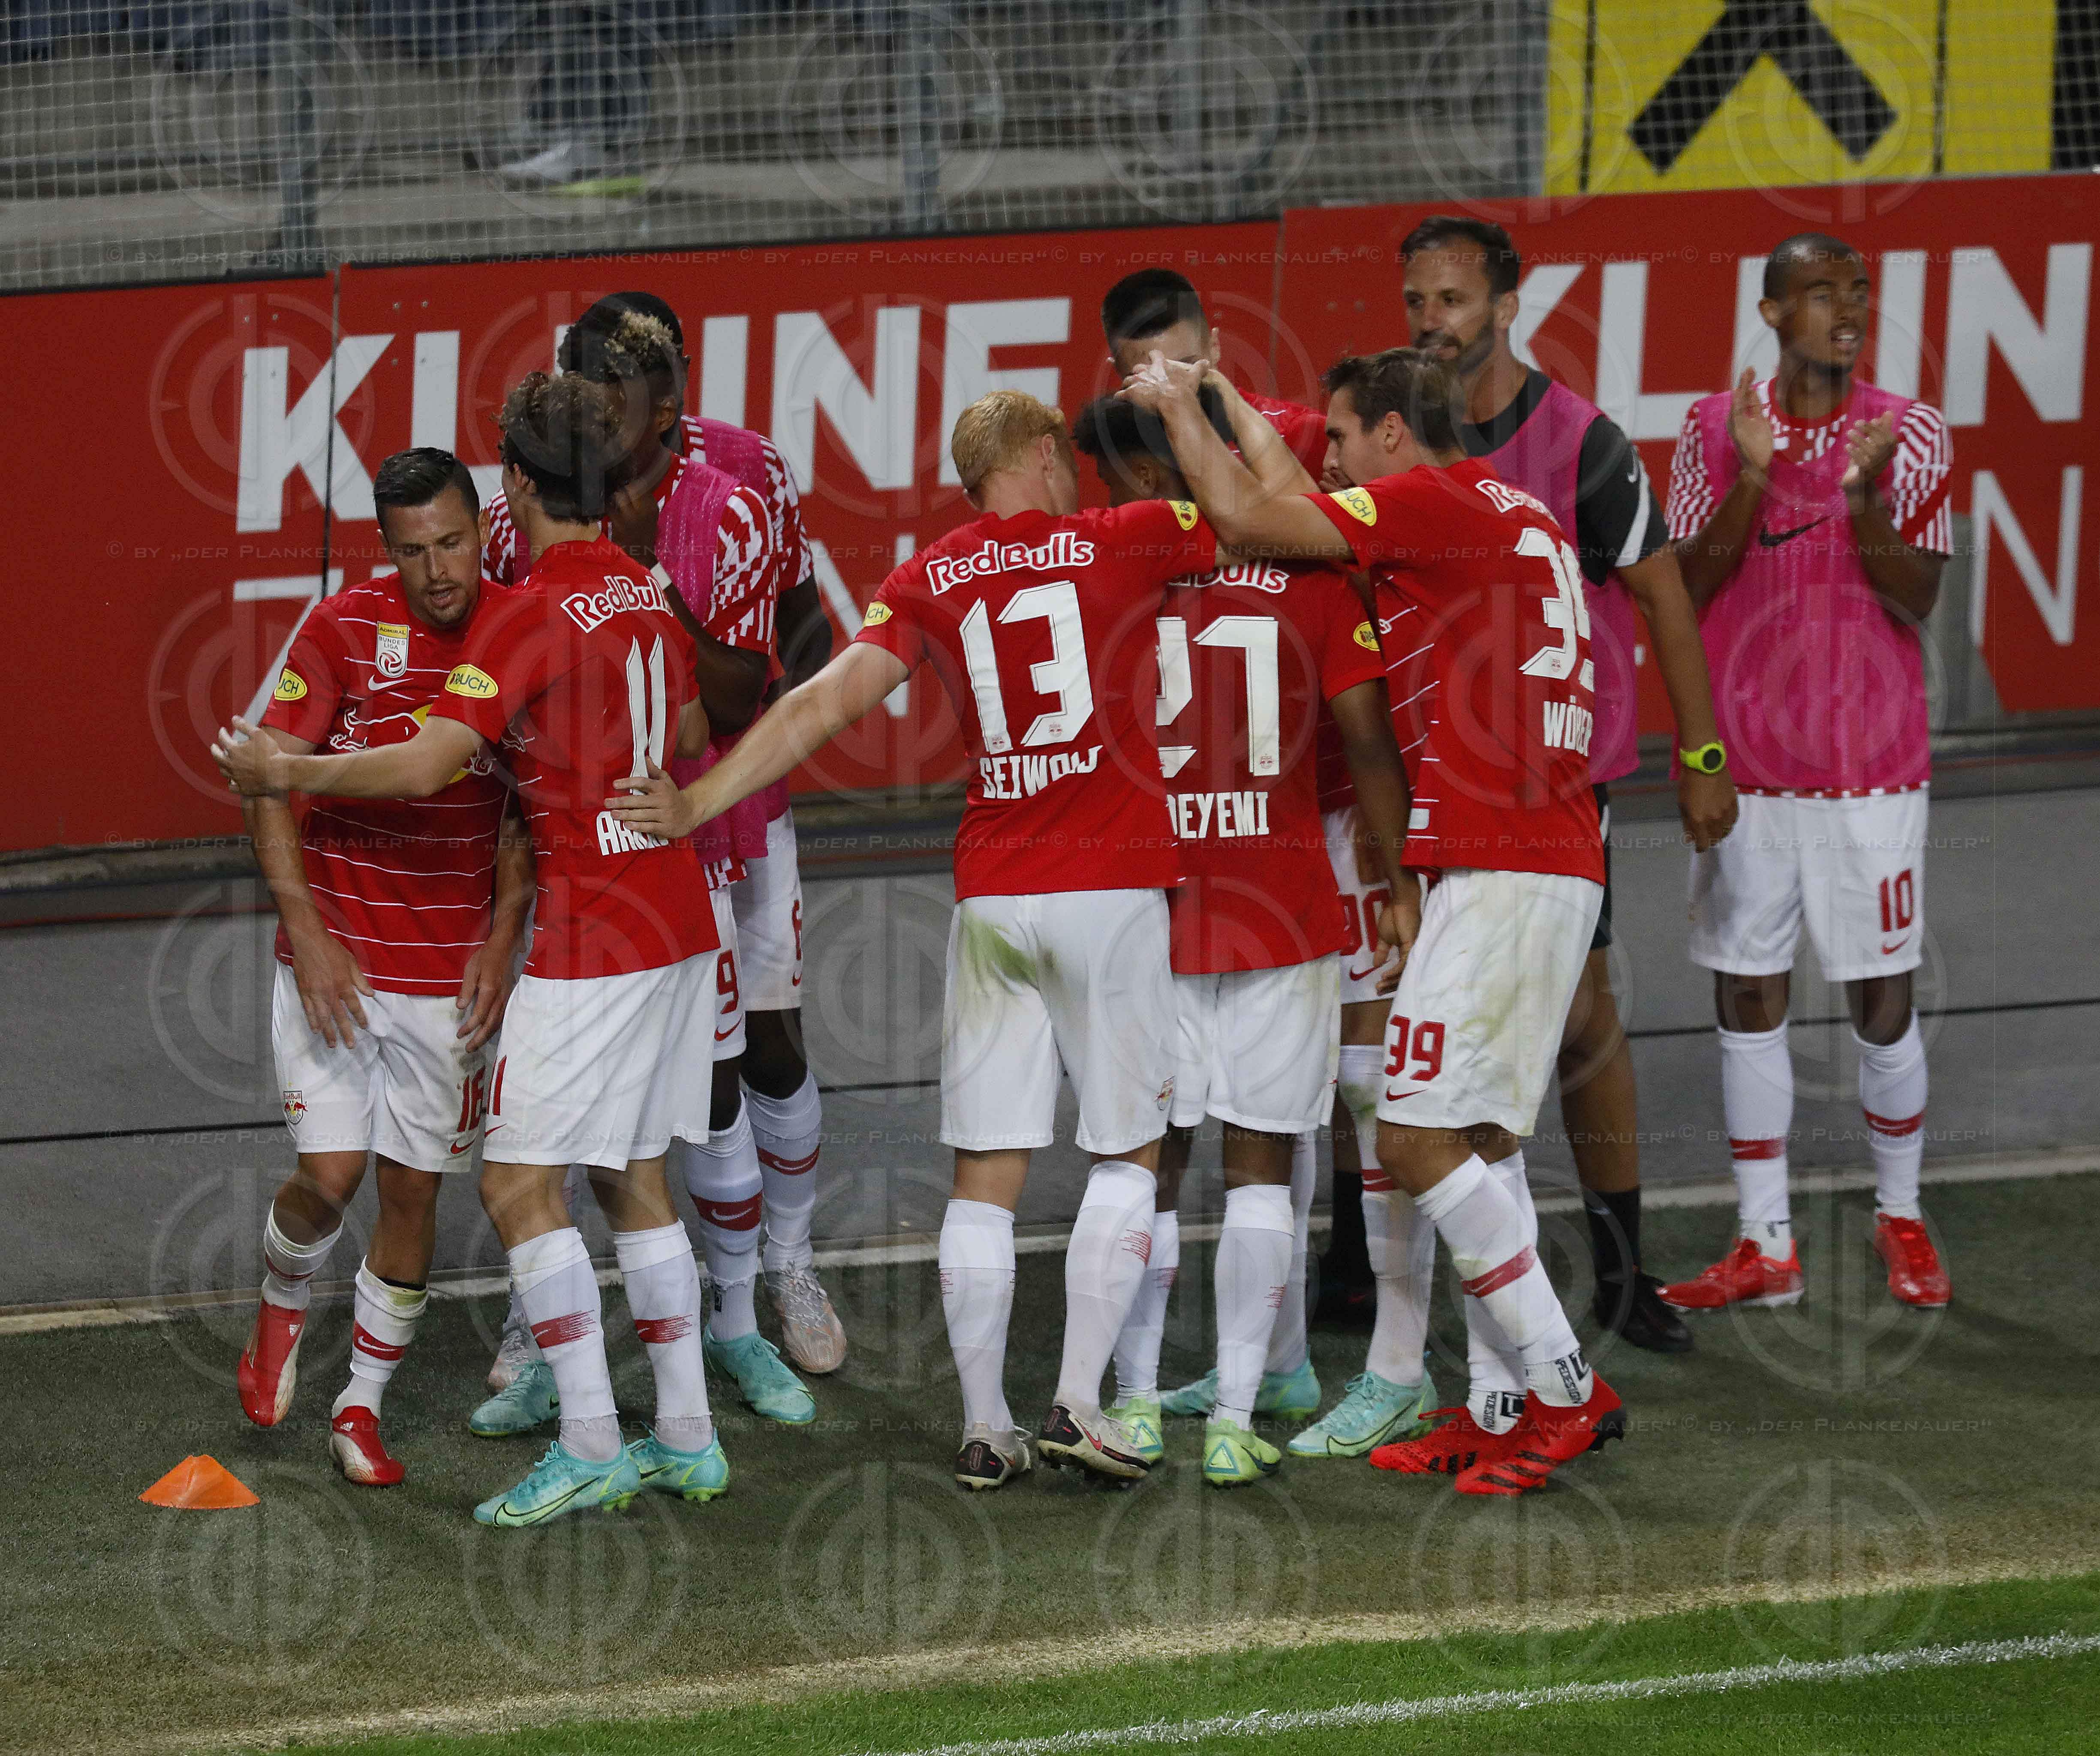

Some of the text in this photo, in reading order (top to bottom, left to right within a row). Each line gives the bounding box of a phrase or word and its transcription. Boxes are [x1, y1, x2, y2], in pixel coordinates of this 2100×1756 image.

[237, 297, 1071, 533] KLINE
[626, 632, 666, 795] 11
[959, 580, 1094, 755] 13
[1879, 867, 1914, 932] 10
[487, 1055, 507, 1116] 1
[1385, 1014, 1445, 1082] 39
